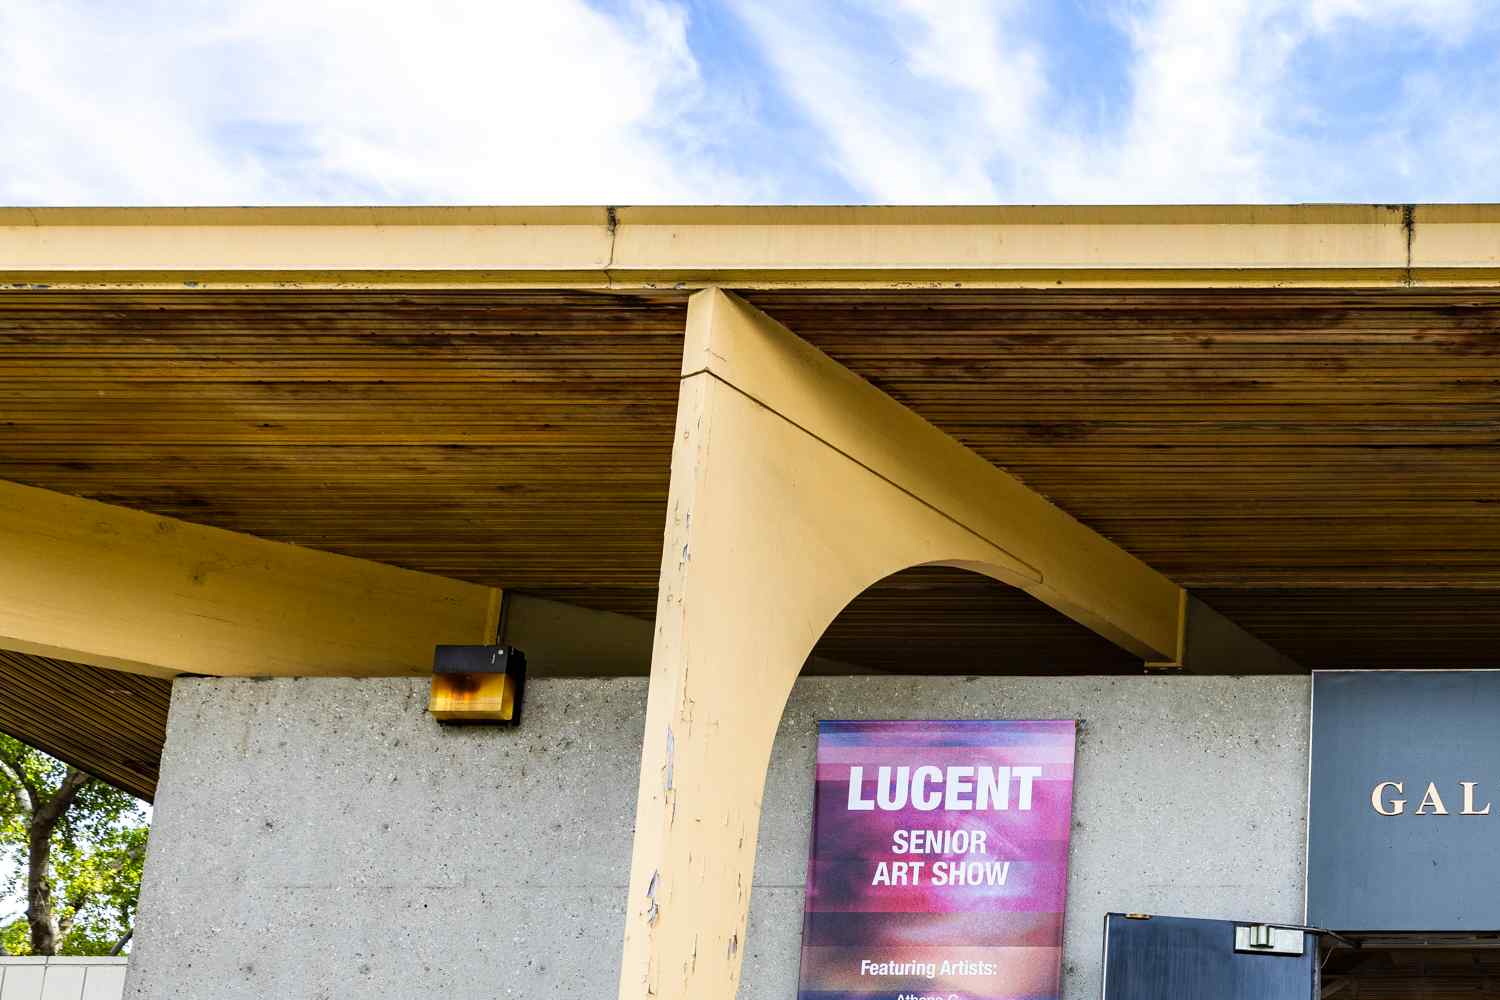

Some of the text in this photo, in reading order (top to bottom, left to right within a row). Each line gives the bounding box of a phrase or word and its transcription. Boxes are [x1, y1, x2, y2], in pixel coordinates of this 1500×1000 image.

[848, 766, 1042, 810] LUCENT
[892, 830, 987, 854] SENIOR
[872, 862, 1010, 886] ART SHOW
[860, 960, 997, 978] Featuring Artists:
